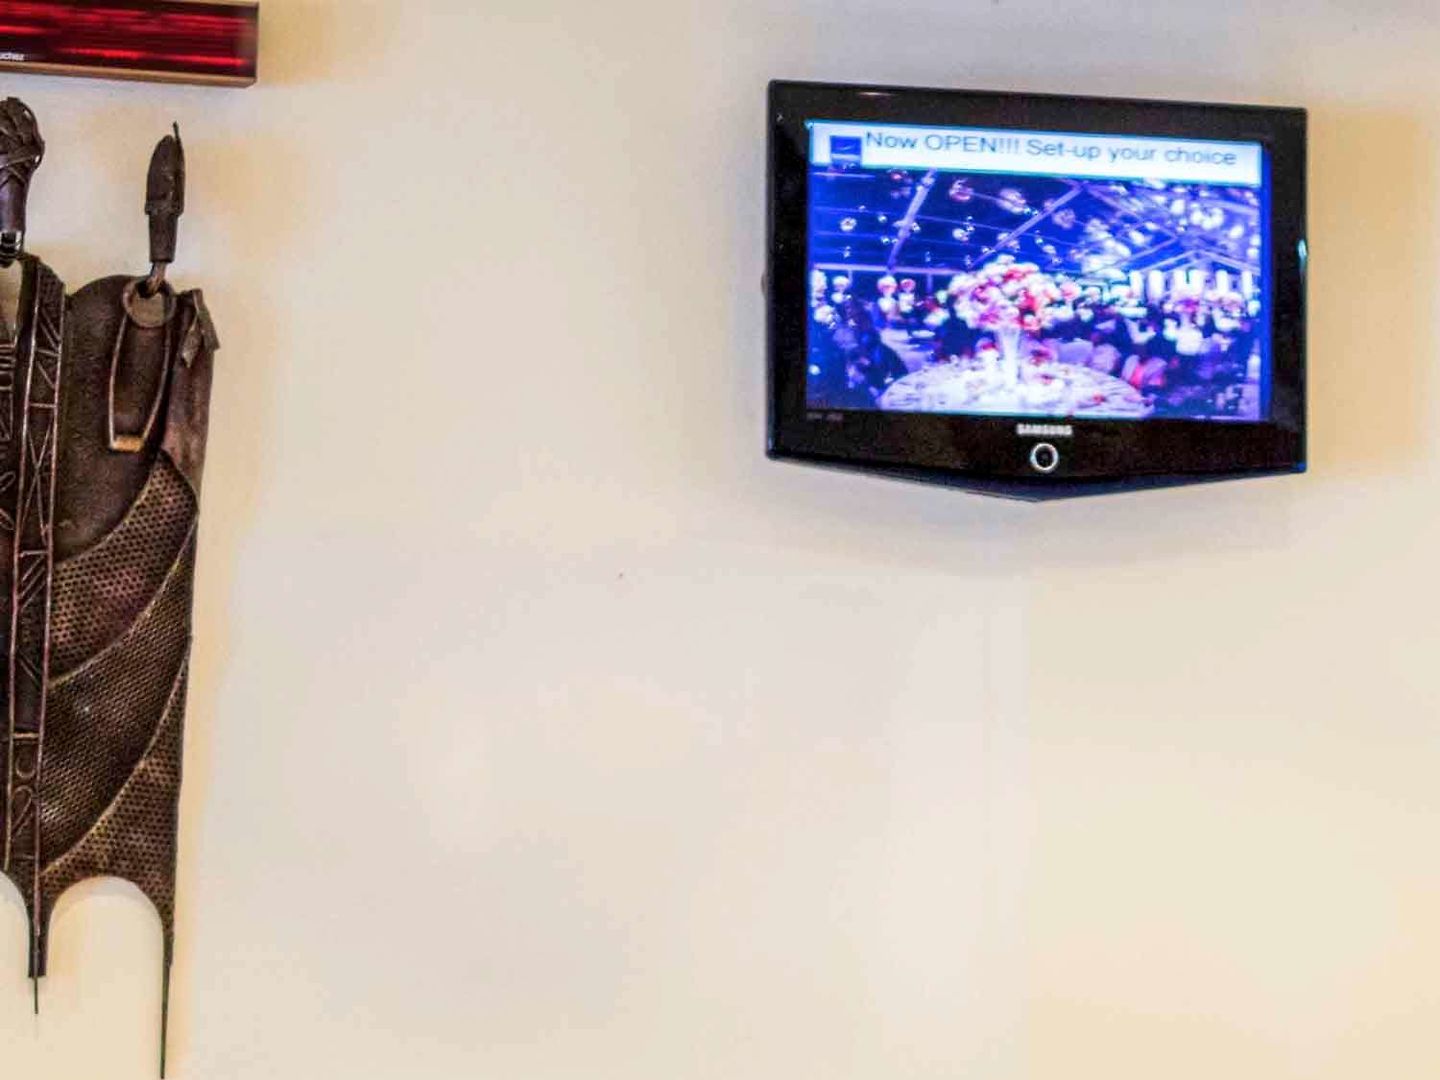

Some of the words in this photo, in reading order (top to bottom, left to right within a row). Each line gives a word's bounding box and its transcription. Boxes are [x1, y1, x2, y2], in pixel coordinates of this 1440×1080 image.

[866, 130, 919, 149] Now
[923, 133, 1020, 154] OPEN!!!
[1027, 138, 1101, 161] Set-up
[1107, 144, 1157, 163] your
[1164, 146, 1237, 166] choice
